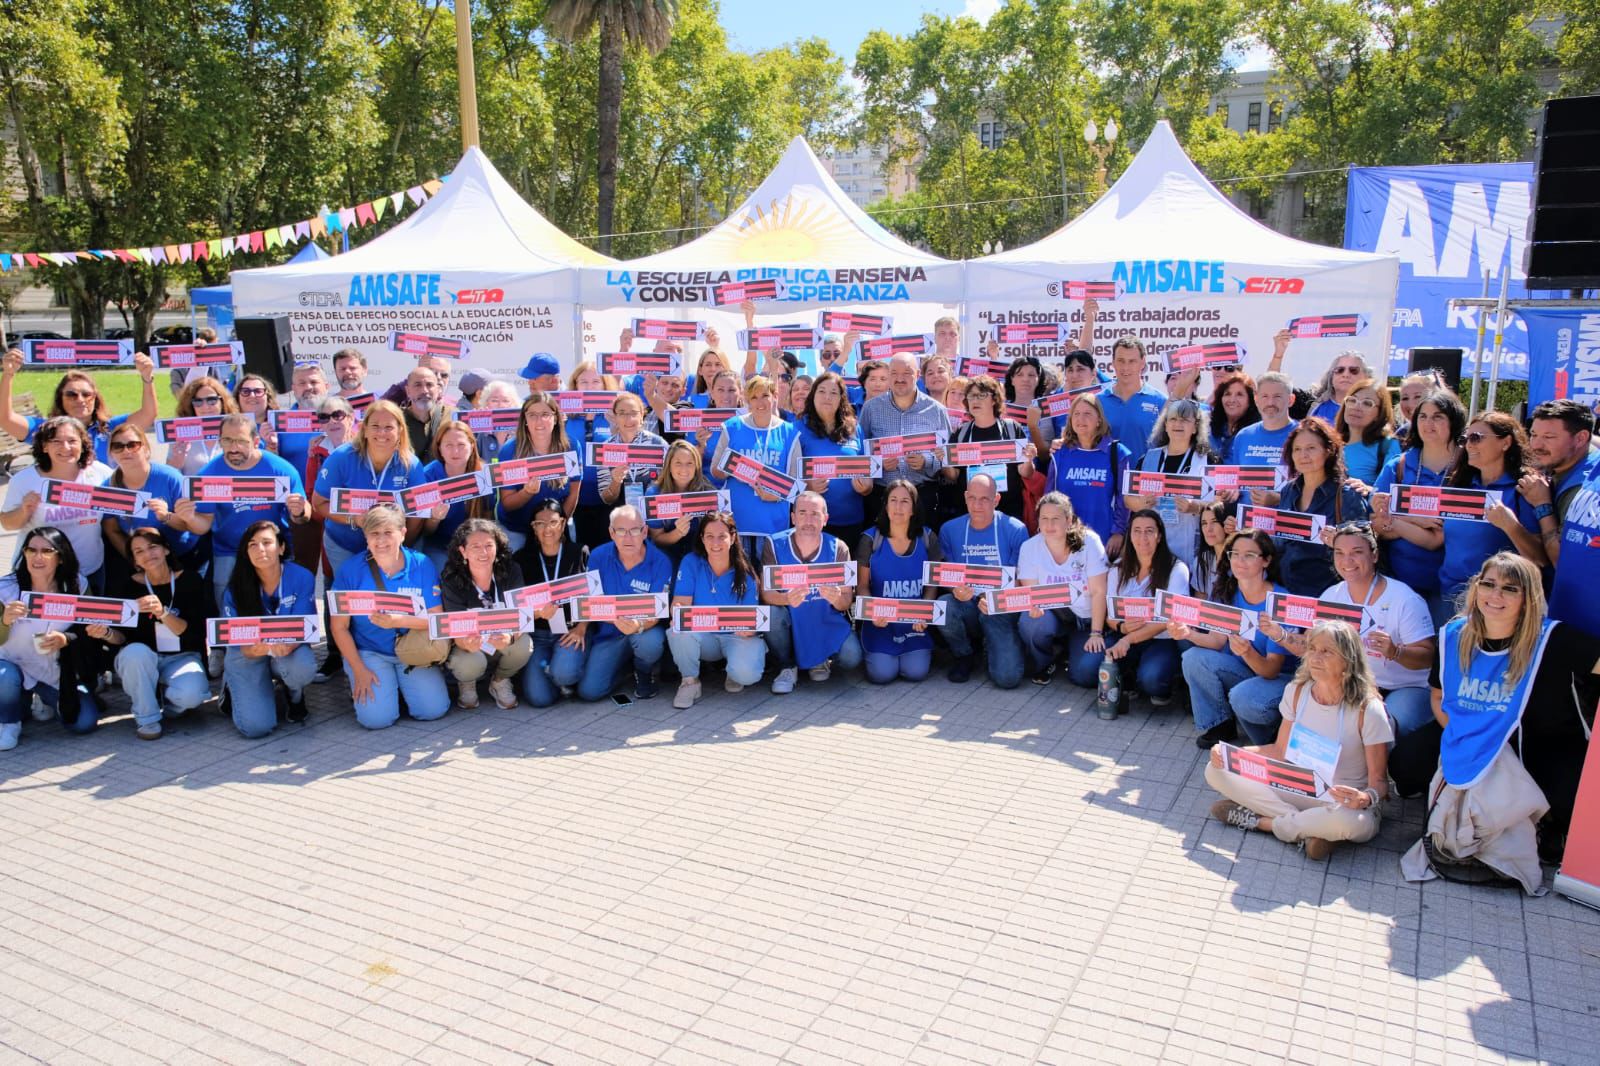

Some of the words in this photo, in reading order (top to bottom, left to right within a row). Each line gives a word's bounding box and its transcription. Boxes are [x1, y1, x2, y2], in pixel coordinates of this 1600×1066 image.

[1375, 179, 1531, 279] AM
[606, 271, 632, 285] LA
[636, 270, 732, 285] ESCUELA
[1112, 259, 1225, 295] AMSAFE
[348, 272, 441, 307] AMSAFE
[621, 287, 636, 302] Y
[638, 286, 707, 303] CONST
[776, 283, 910, 302] SPERANZA
[287, 311, 322, 320] FENSA
[324, 311, 345, 320] DEL
[346, 310, 398, 320] DERECHO
[399, 309, 440, 320] SOCIAL
[441, 310, 450, 319] A
[450, 309, 465, 319] LA
[466, 305, 536, 318] EDUCACIÓN,
[537, 306, 552, 316] LA
[1008, 309, 1068, 324] historia
[1119, 307, 1221, 324] trabajadoras
[307, 320, 354, 333] PÚBLICA
[355, 323, 363, 332] Y
[365, 322, 386, 332] LOS
[387, 321, 448, 331] DERECHOS
[449, 319, 514, 331] LABORALES
[515, 318, 530, 328] DE
[532, 317, 554, 328] LAS
[1139, 326, 1187, 339] nunca
[1189, 322, 1240, 342] puede
[298, 336, 306, 345] Y
[307, 335, 329, 345] LOS
[330, 334, 389, 345] TRABAJAD
[294, 353, 331, 362] OVINCIA:
[1004, 342, 1069, 358] solitaria
[1066, 467, 1107, 481] AMSAFE
[883, 580, 923, 598] AMSAF
